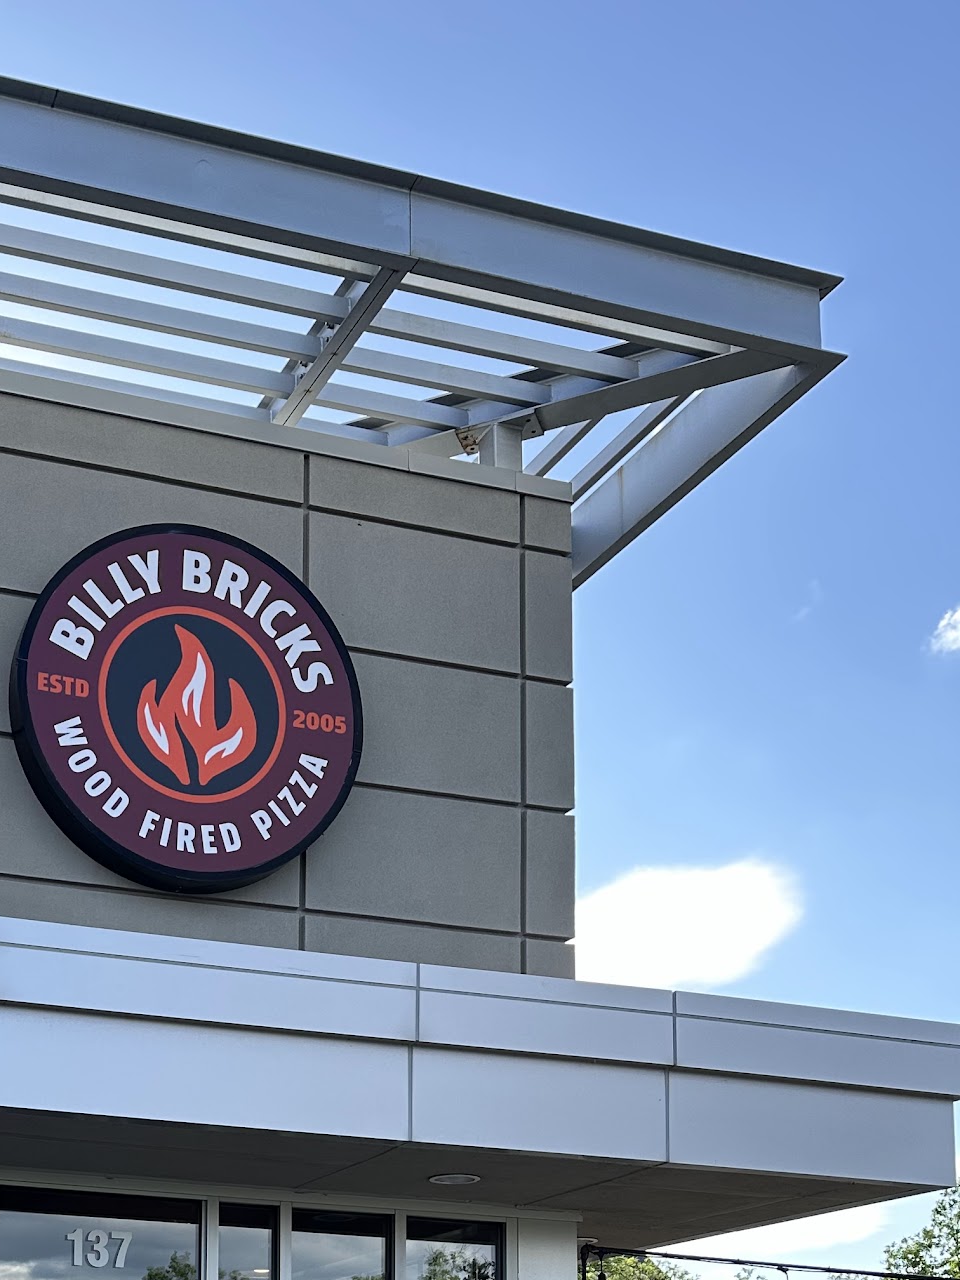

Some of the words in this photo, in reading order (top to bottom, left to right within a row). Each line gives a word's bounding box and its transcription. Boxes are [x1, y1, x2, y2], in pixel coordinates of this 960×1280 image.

[49, 549, 161, 660] BILLY
[182, 549, 334, 693] BRICKS
[37, 672, 90, 698] ESTD
[292, 710, 347, 734] 2005
[53, 715, 130, 818] WOOD
[138, 810, 241, 854] FIRED
[250, 752, 329, 840] PIZZA
[66, 1228, 132, 1268] 137
